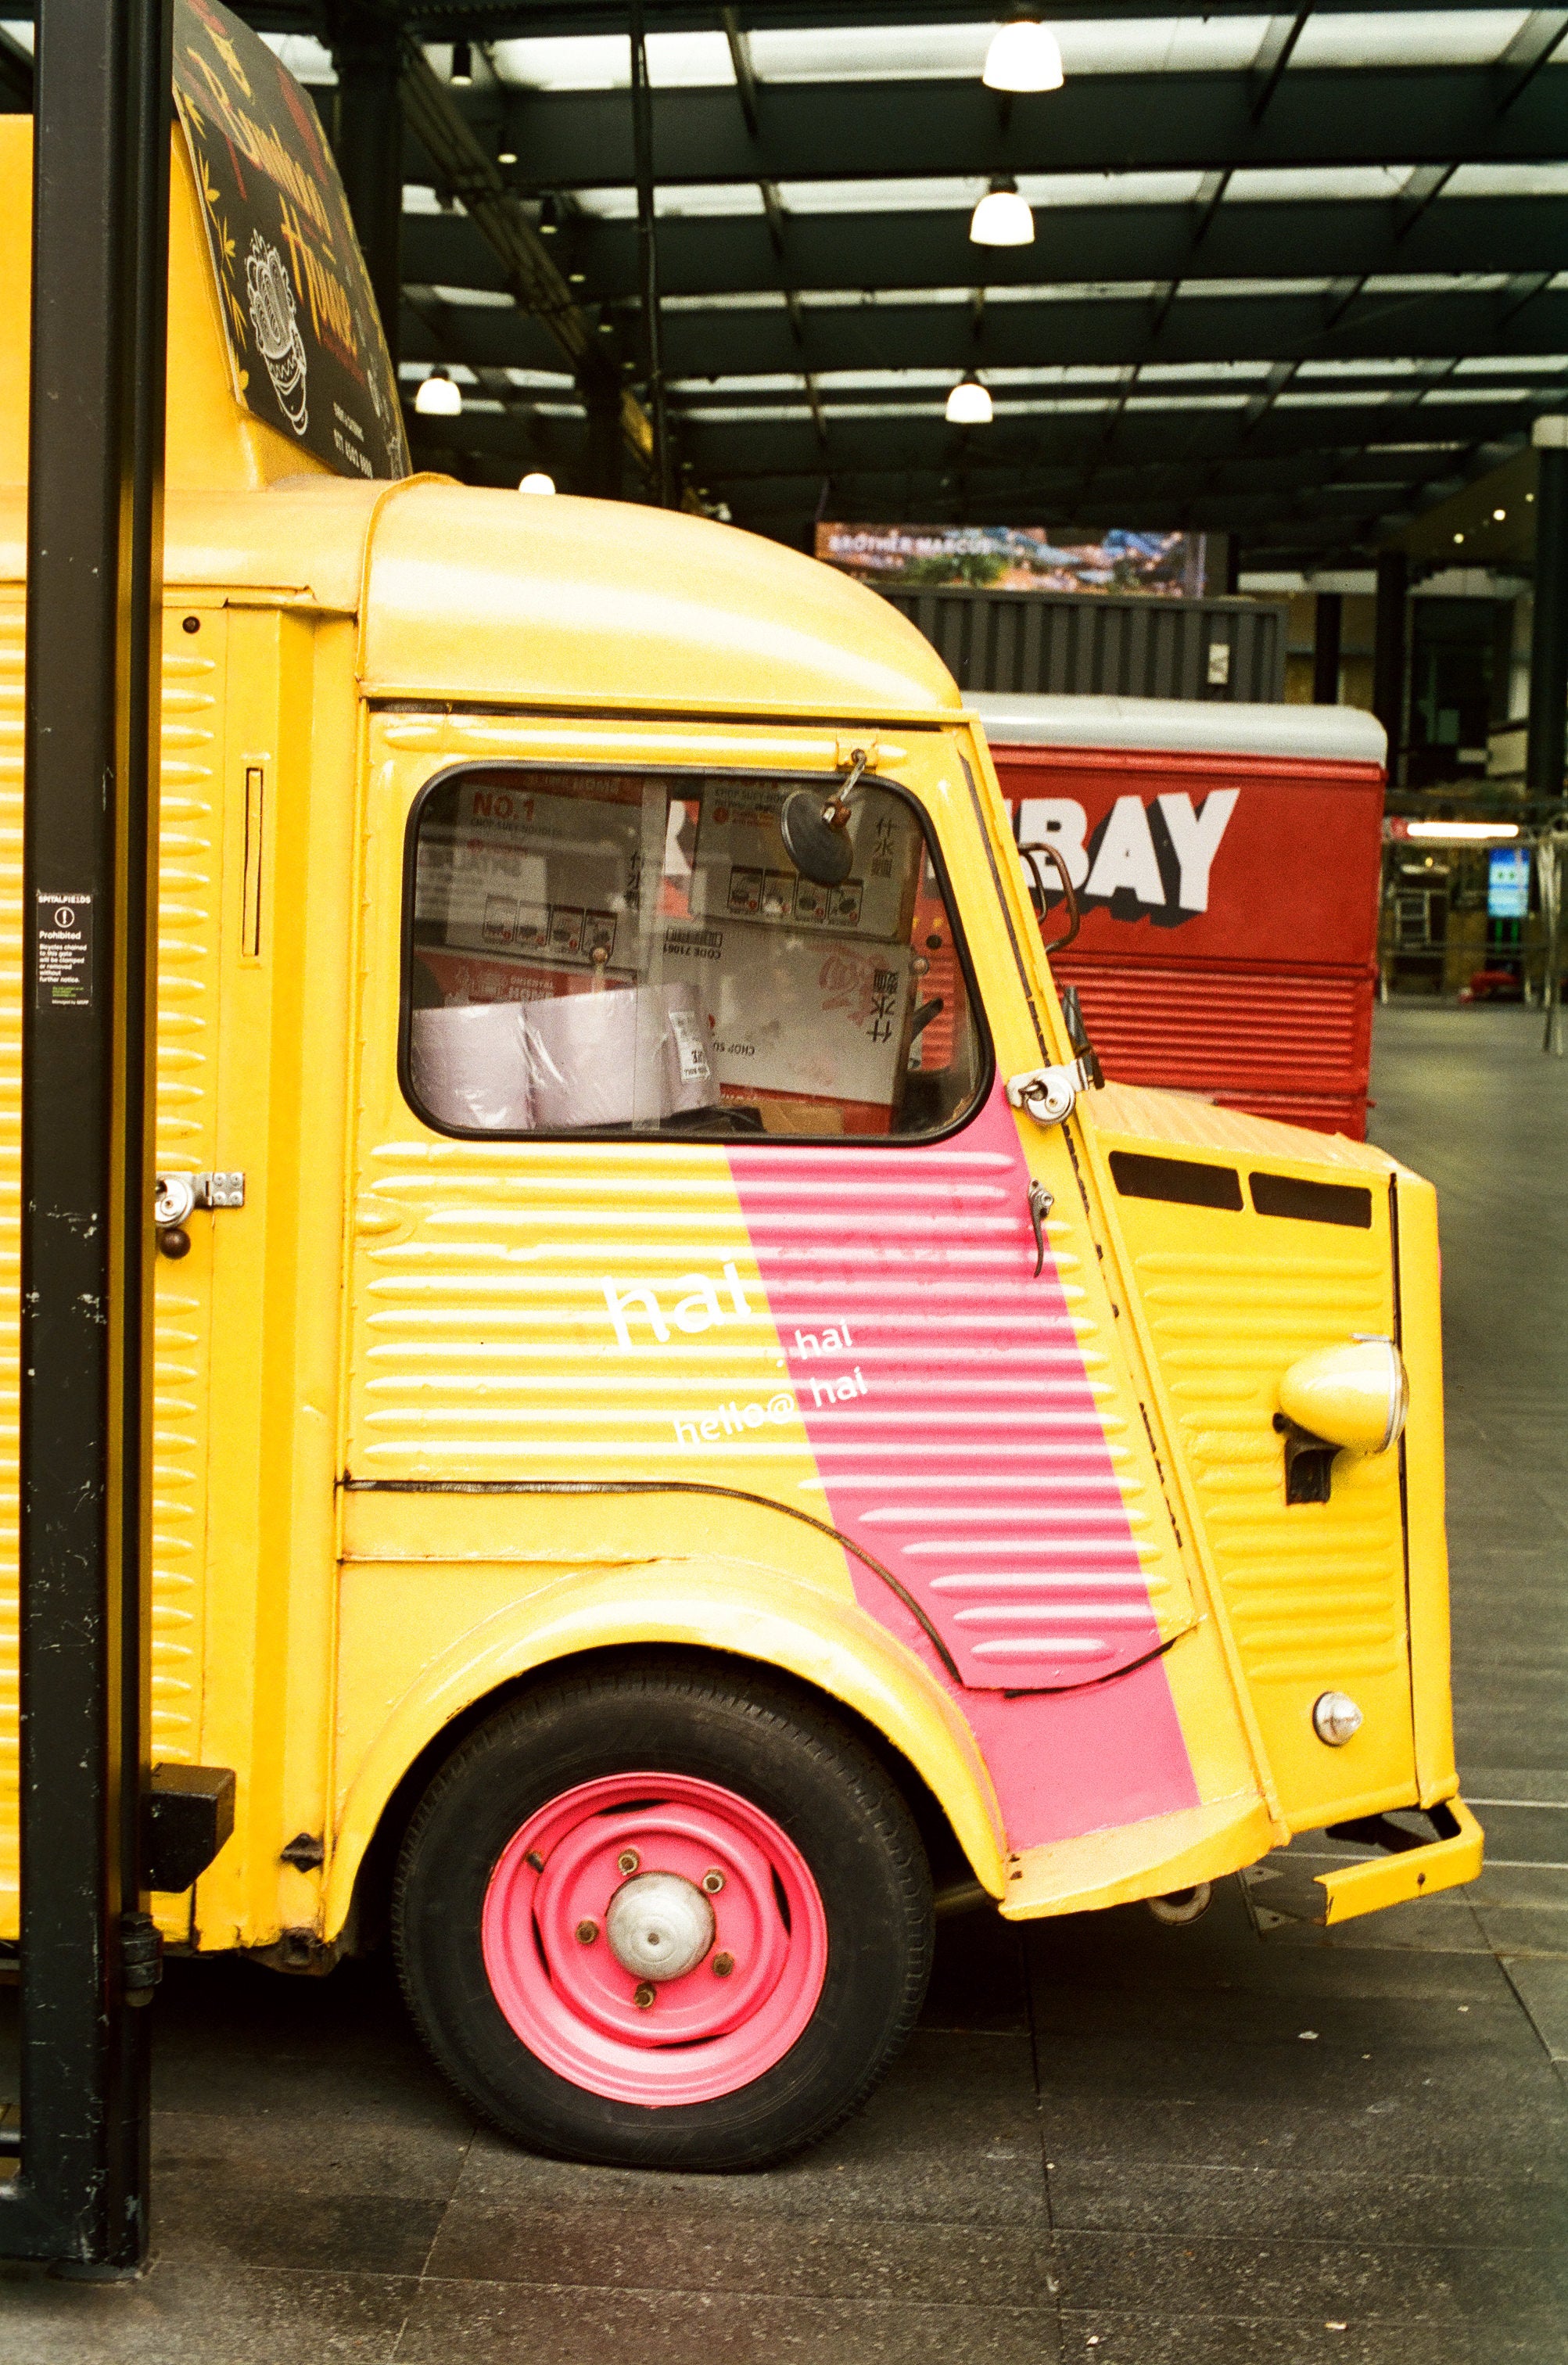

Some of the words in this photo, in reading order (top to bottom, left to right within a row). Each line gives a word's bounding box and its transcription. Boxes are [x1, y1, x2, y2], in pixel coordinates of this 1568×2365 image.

[279, 193, 358, 358] House
[472, 791, 536, 823] NO.1
[1005, 787, 1241, 913] BAY
[38, 895, 91, 904] SPITALFIELDS
[39, 930, 81, 940] Prohibited
[601, 1248, 752, 1352] hai
